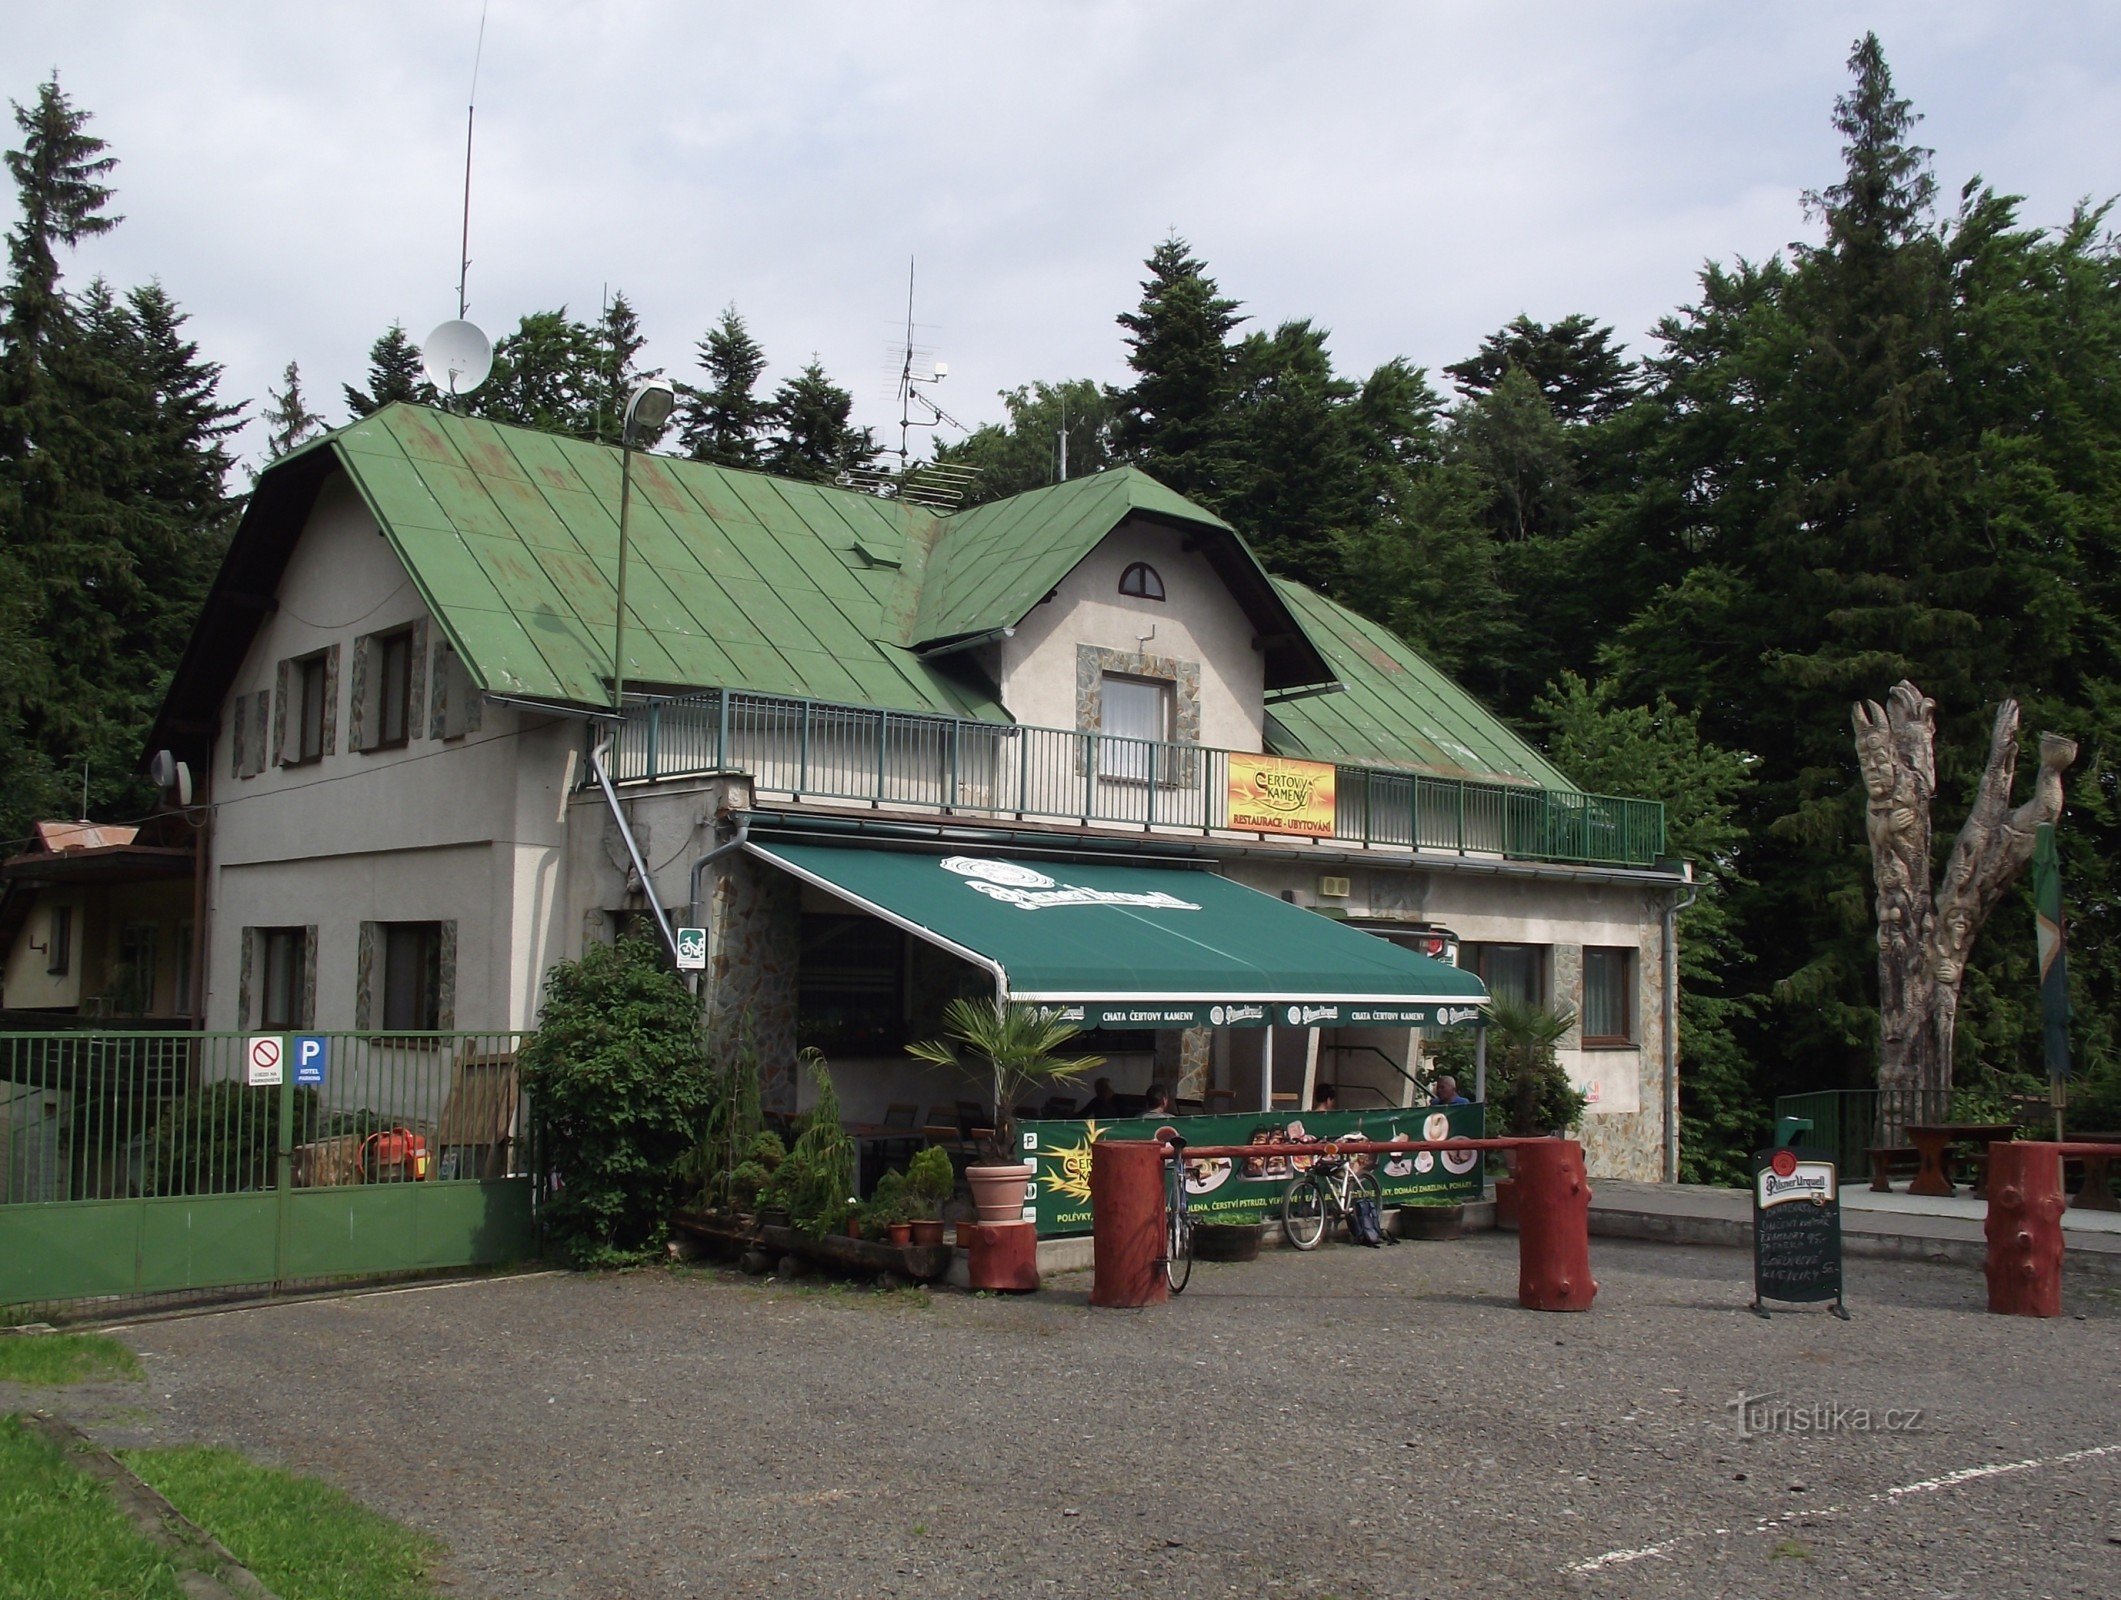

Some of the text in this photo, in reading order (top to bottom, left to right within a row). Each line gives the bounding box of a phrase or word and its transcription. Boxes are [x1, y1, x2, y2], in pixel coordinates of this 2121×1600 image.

[1233, 814, 1283, 828] RESTAURACE
[1287, 819, 1331, 832] UBYTOVÁNÍ
[1103, 1009, 1194, 1021] CHATA ČERTOVY KAMENY
[1352, 1012, 1371, 1020] CHATA
[302, 1041, 320, 1066] P
[1394, 1184, 1418, 1195] DOMÁCÍ
[1766, 1175, 1825, 1196] Pilsner Urquell
[1212, 1199, 1238, 1210] ČERSTVÍ
